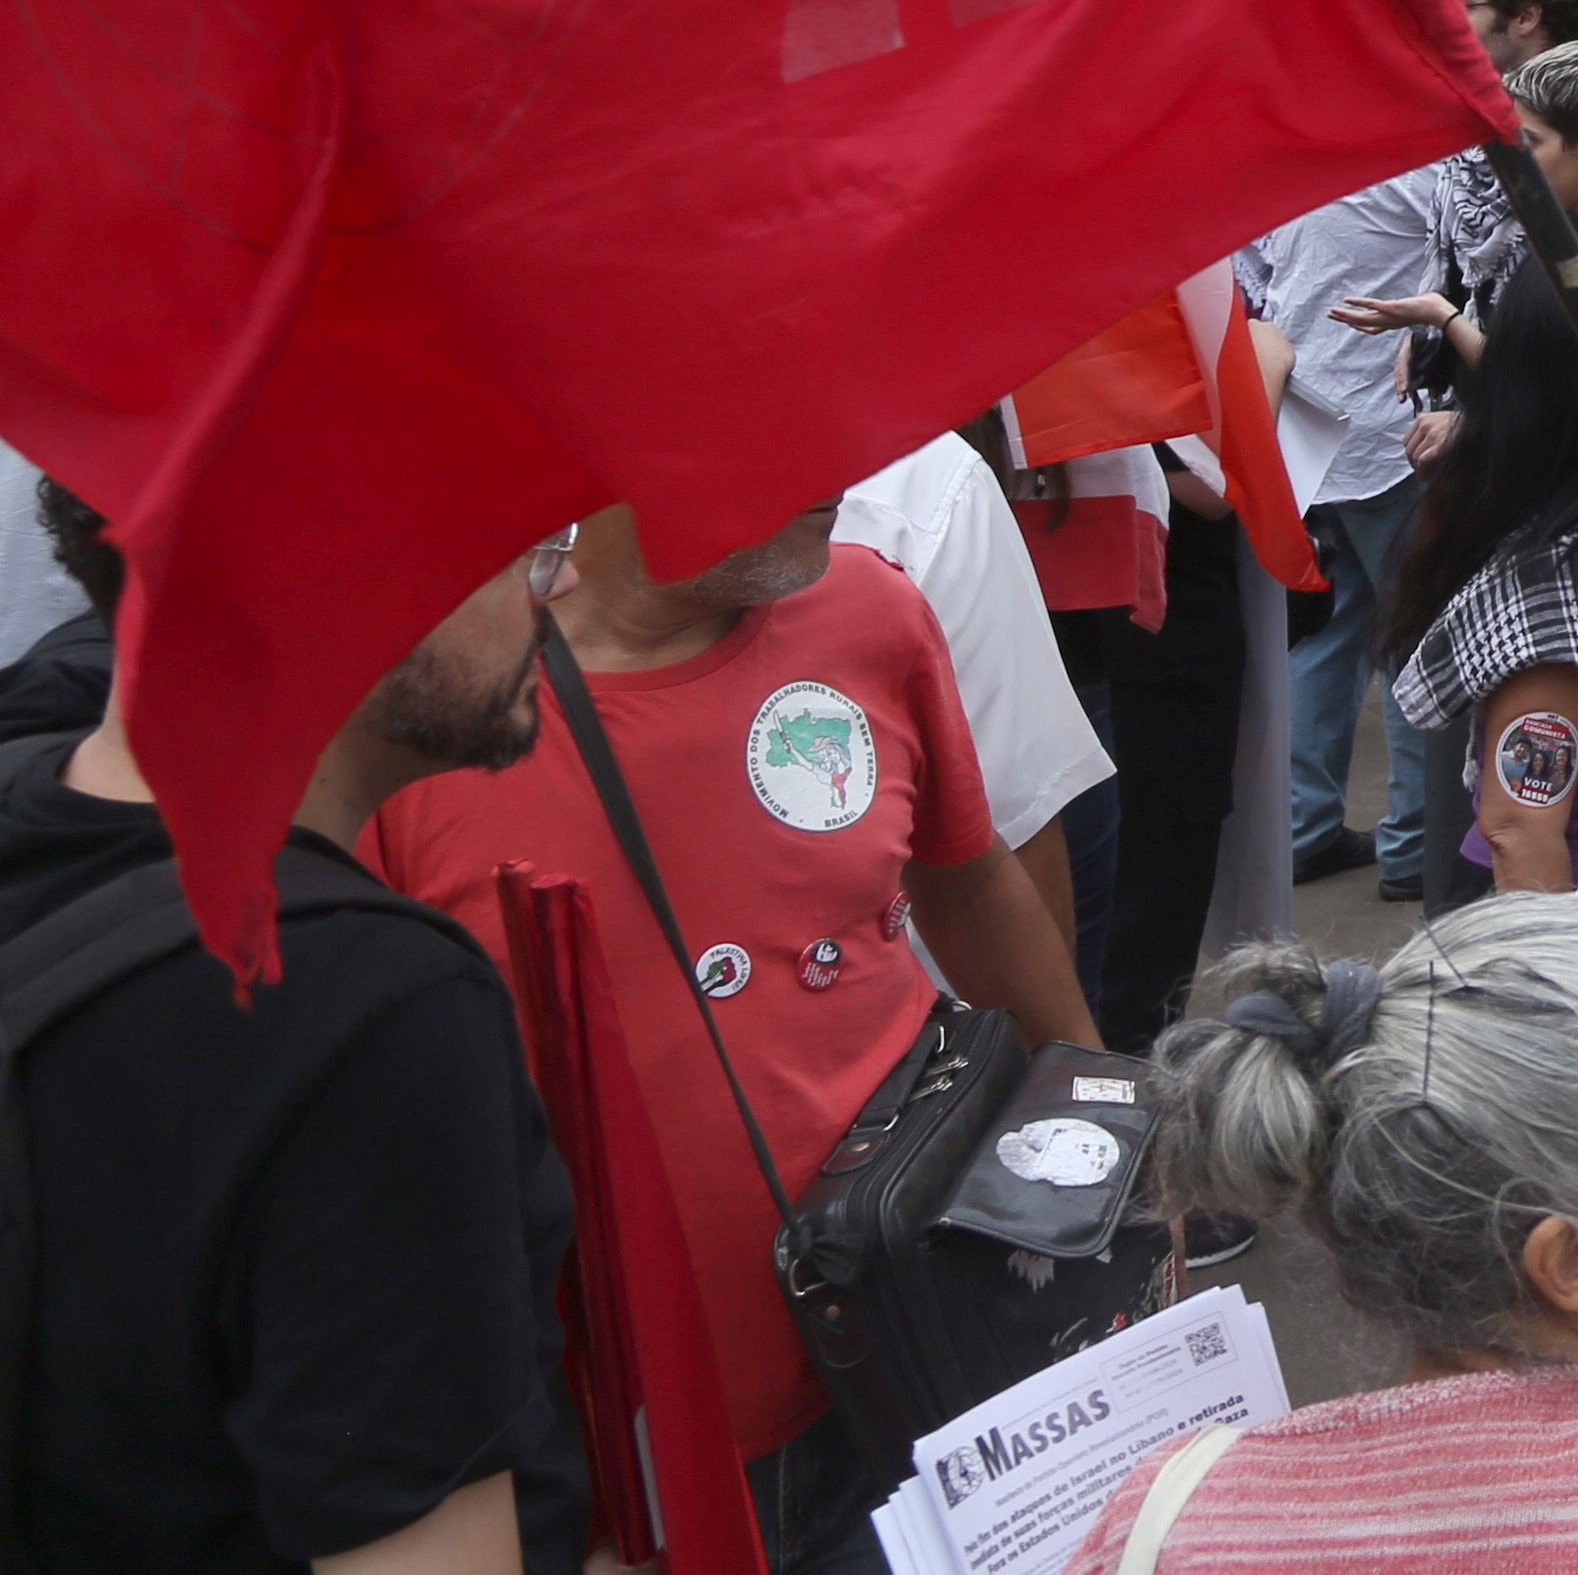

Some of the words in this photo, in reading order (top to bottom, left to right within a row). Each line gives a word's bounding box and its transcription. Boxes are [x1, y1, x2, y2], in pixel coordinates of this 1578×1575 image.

[756, 684, 826, 724] TRABALHADORES
[829, 691, 862, 720] RURAIS
[751, 729, 760, 752] DOS
[859, 721, 871, 747] SEM
[1523, 725, 1566, 739] COMUNISTA
[866, 752, 874, 787] TERRA
[1524, 777, 1553, 791] VOTE
[751, 757, 789, 819] MOVIMENTO
[1522, 789, 1549, 802] 16555
[825, 810, 858, 827] BRASIL
[973, 1388, 1112, 1482] MASSAS
[990, 1519, 1009, 1535] dos
[1009, 1492, 1052, 1523] ataques
[1052, 1480, 1069, 1496] de
[1069, 1459, 1107, 1486] Israel
[1108, 1450, 1126, 1466] no
[1127, 1426, 1175, 1455] Líbano
[1176, 1420, 1187, 1431] e
[1188, 1392, 1244, 1425] retirada
[999, 1534, 1013, 1548] de
[1012, 1518, 1037, 1538] suas
[1076, 1463, 1132, 1501] militares
[1018, 1521, 1060, 1553] Estados
[1061, 1496, 1104, 1526] Unidos
